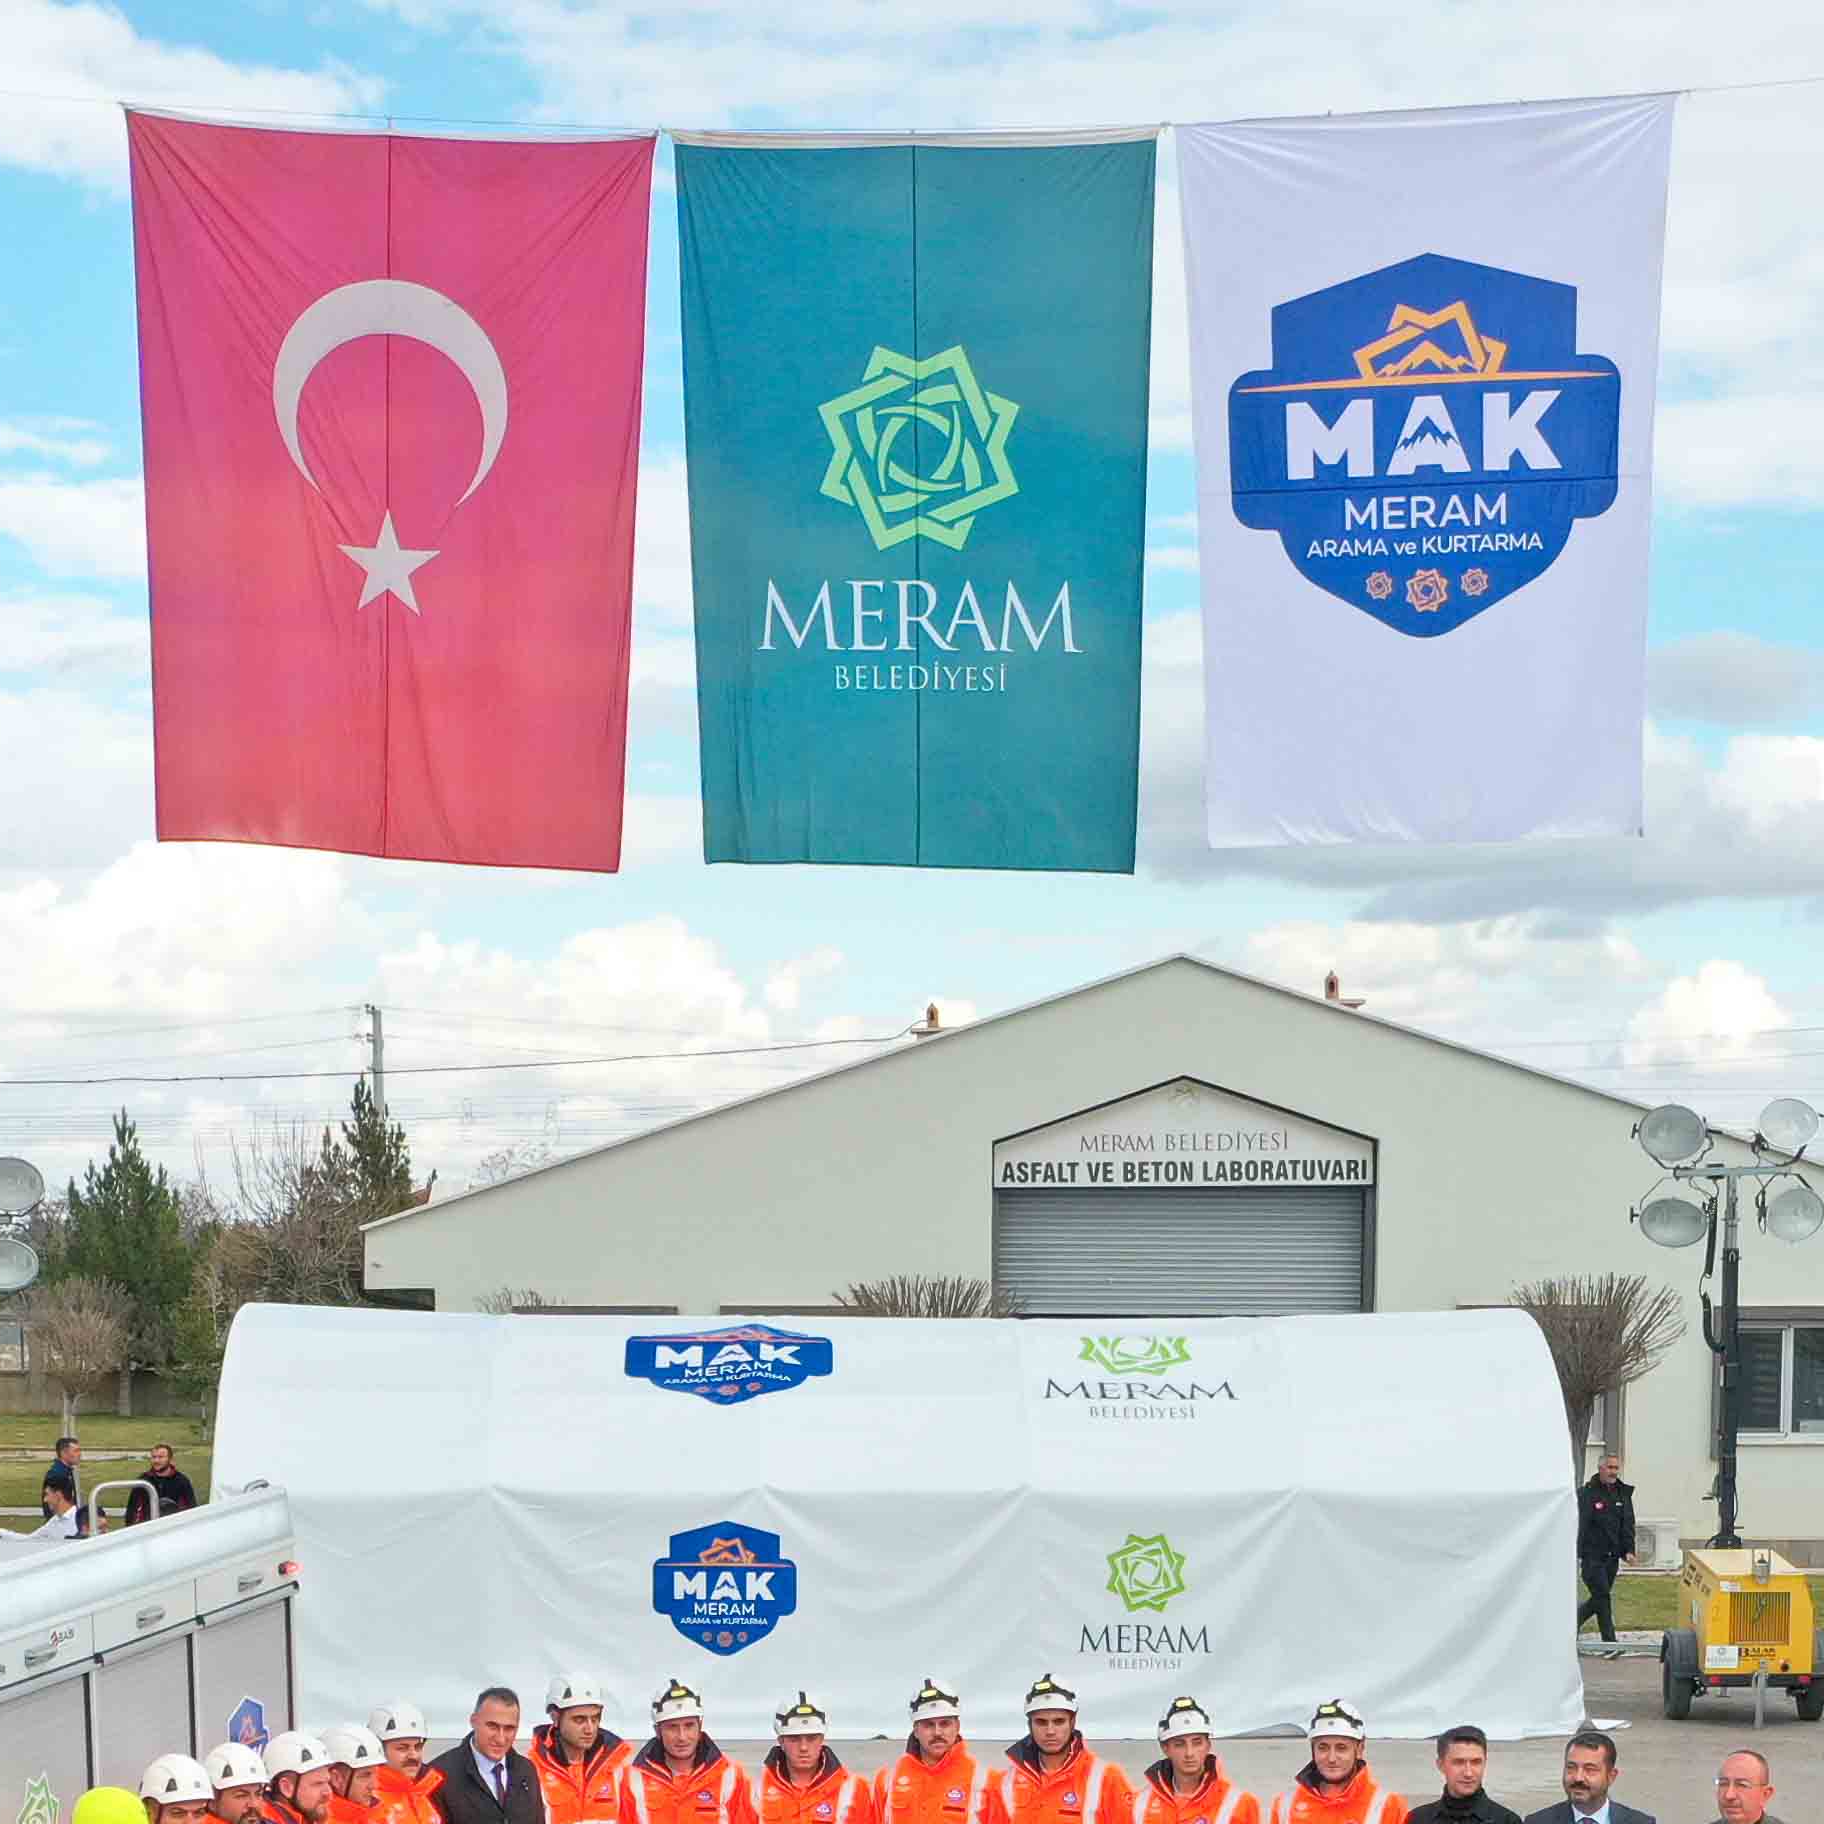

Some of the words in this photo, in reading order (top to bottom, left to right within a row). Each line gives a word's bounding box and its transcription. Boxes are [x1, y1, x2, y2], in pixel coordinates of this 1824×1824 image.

[1285, 389, 1564, 481] MAK
[1344, 492, 1508, 532] MERAM
[1306, 537, 1389, 560] ARAMA
[1392, 541, 1417, 556] ve
[1421, 531, 1544, 556] KURTARMA
[757, 577, 1089, 654] MERAM
[833, 660, 1008, 692] BELEDİYESİ
[1079, 1133, 1155, 1153] MERAM
[1164, 1129, 1289, 1152] BELEDİYESİ
[1001, 1160, 1080, 1184] ASFALT
[1087, 1161, 1114, 1183] VE
[1122, 1160, 1194, 1183] BETON
[1202, 1159, 1368, 1182] LABORATUVARI
[654, 1341, 802, 1369] MAK
[683, 1360, 773, 1378] MERAM
[1044, 1377, 1241, 1401] MERAM
[1089, 1403, 1196, 1420] BELEDİYESİ
[673, 1571, 776, 1601] MAK
[693, 1601, 756, 1616] MERAM
[1077, 1622, 1213, 1654] MERAM
